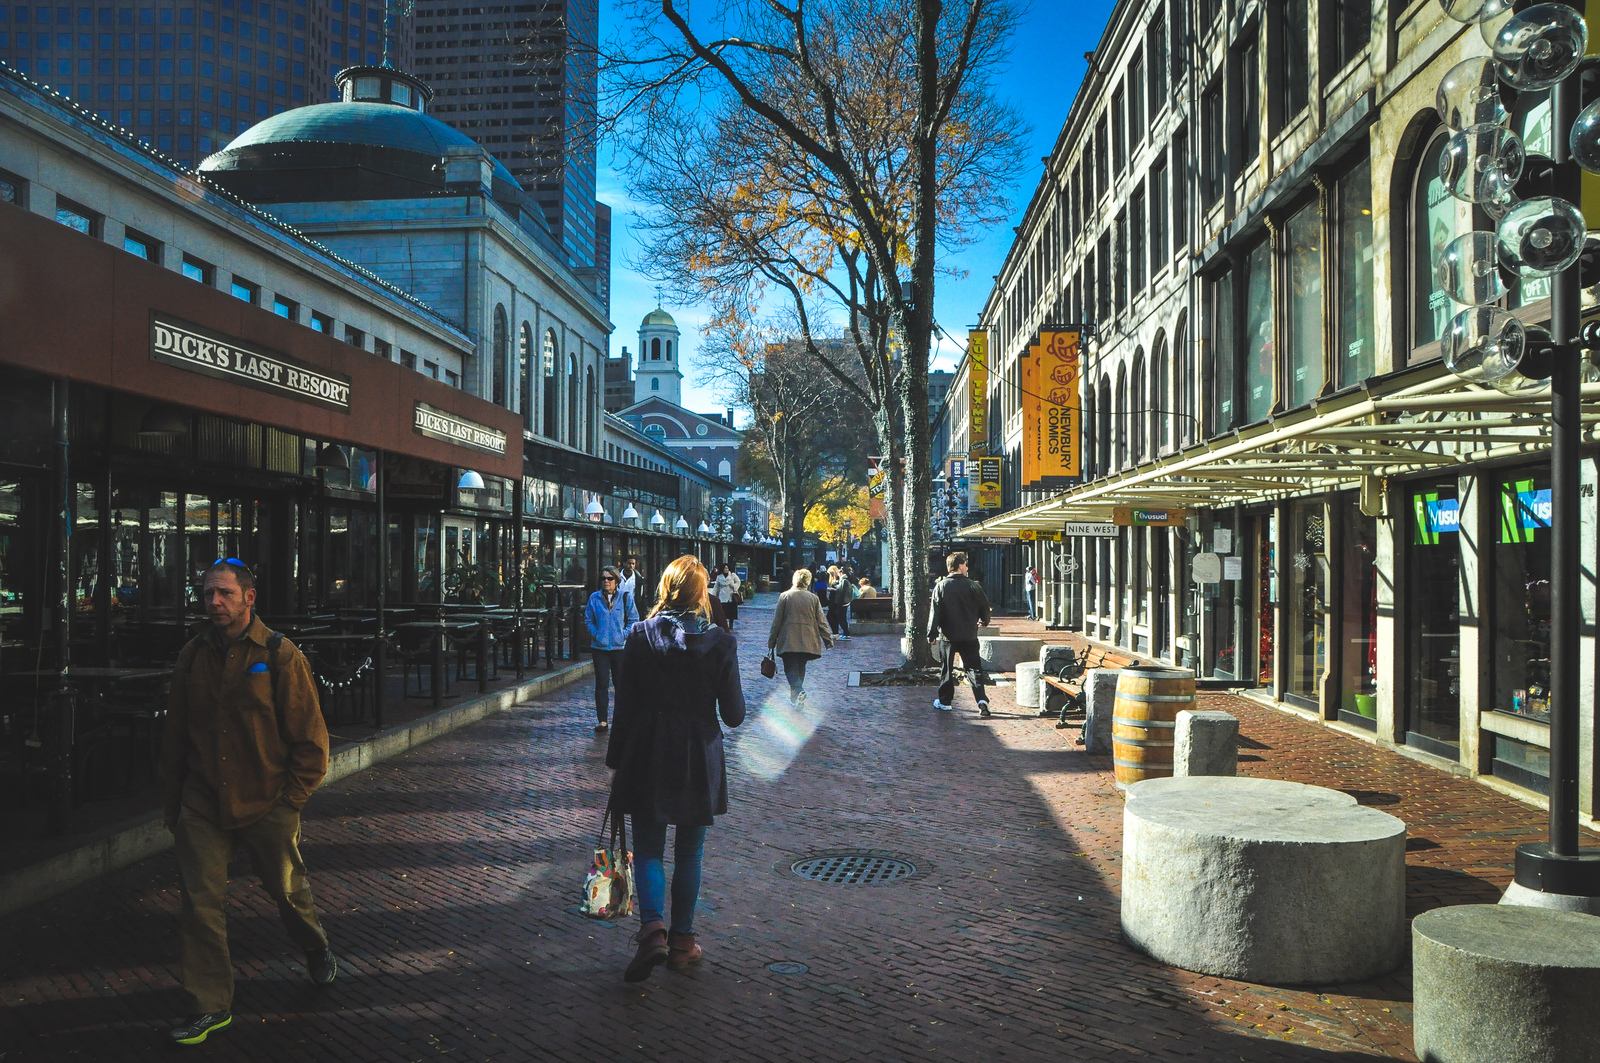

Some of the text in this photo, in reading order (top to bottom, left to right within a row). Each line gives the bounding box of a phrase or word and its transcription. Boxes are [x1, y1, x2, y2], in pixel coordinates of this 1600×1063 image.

[154, 326, 349, 403] DICK'S LAST RESORT
[415, 410, 505, 451] DICK'S LAST RESORT
[1048, 407, 1059, 455] COMICS
[1060, 407, 1071, 470] NEWBURY
[1068, 525, 1116, 533] NINE WEST
